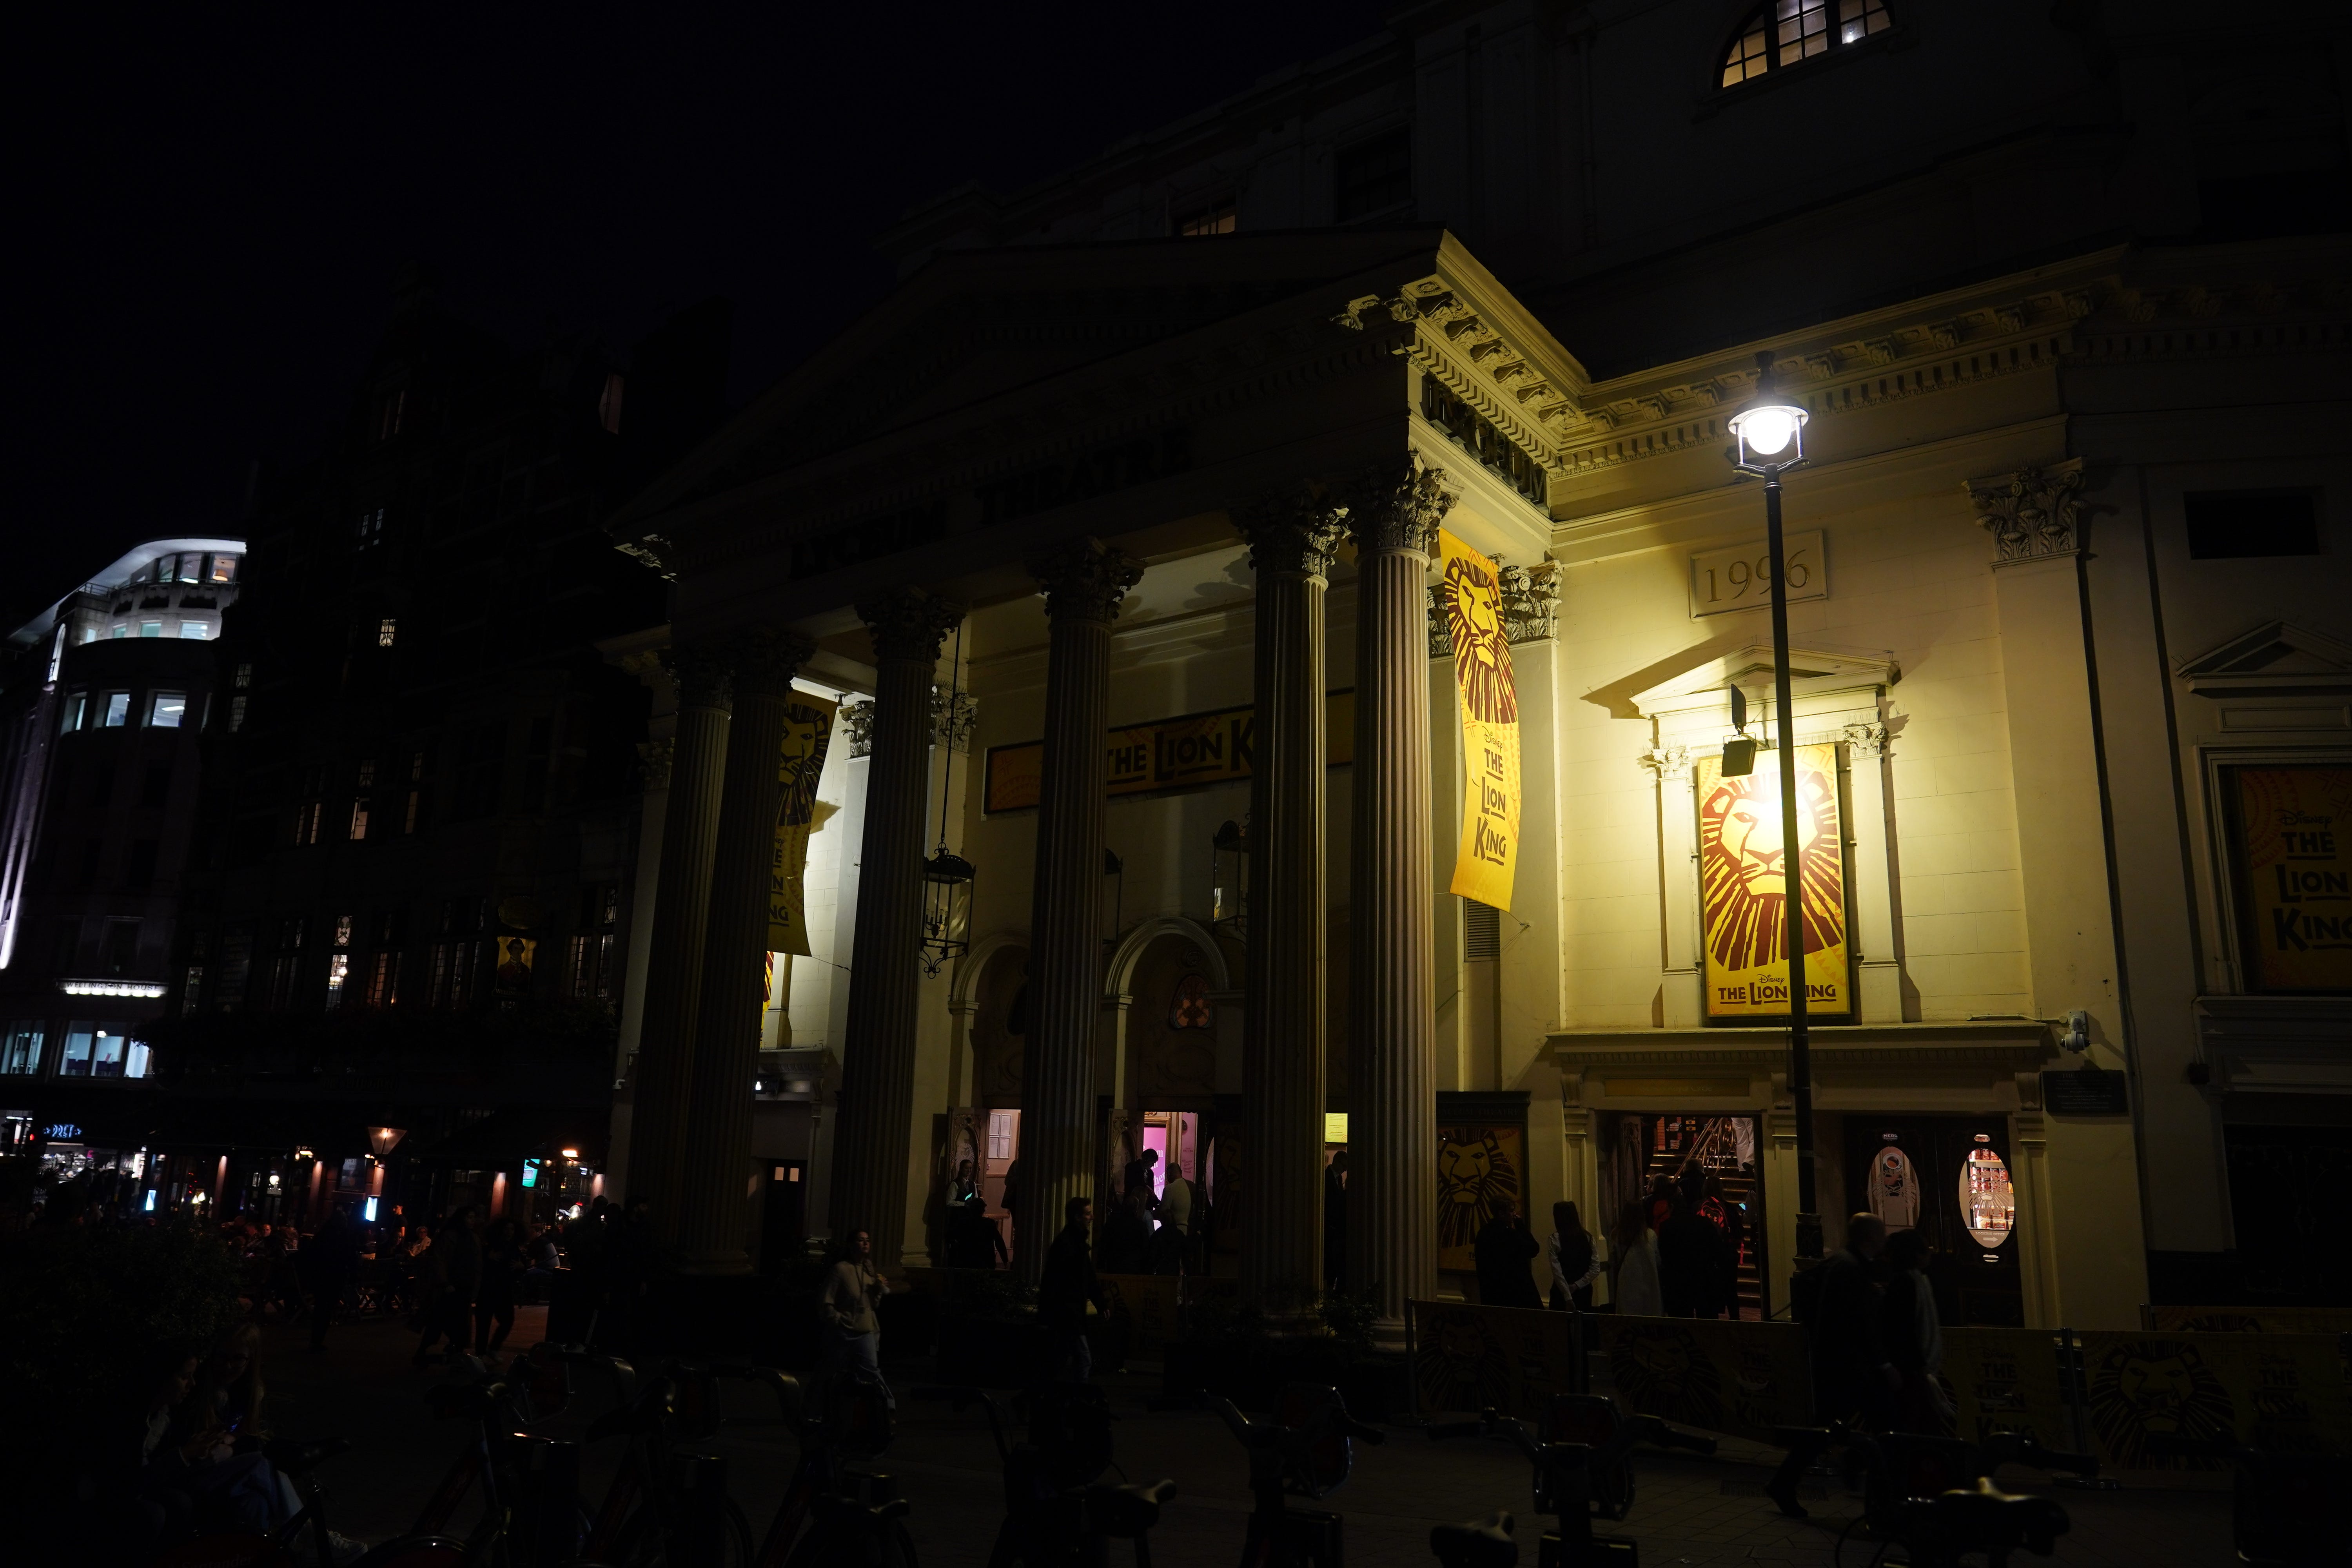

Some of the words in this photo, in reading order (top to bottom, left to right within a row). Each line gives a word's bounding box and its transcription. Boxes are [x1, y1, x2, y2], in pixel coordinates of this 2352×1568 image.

[790, 501, 947, 578] LYCEUM
[975, 426, 1192, 526] THEATRE
[1484, 748, 1503, 775] THE
[1474, 817, 1506, 861] KING
[2281, 831, 2336, 853] THE
[1718, 987, 1746, 1000] THE
[1805, 984, 1836, 1000] ING
[1522, 1337, 1545, 1352] THE
[1740, 1351, 1771, 1367] THE
[1982, 1363, 2018, 1379] THE
[2258, 1368, 2299, 1387] THE
